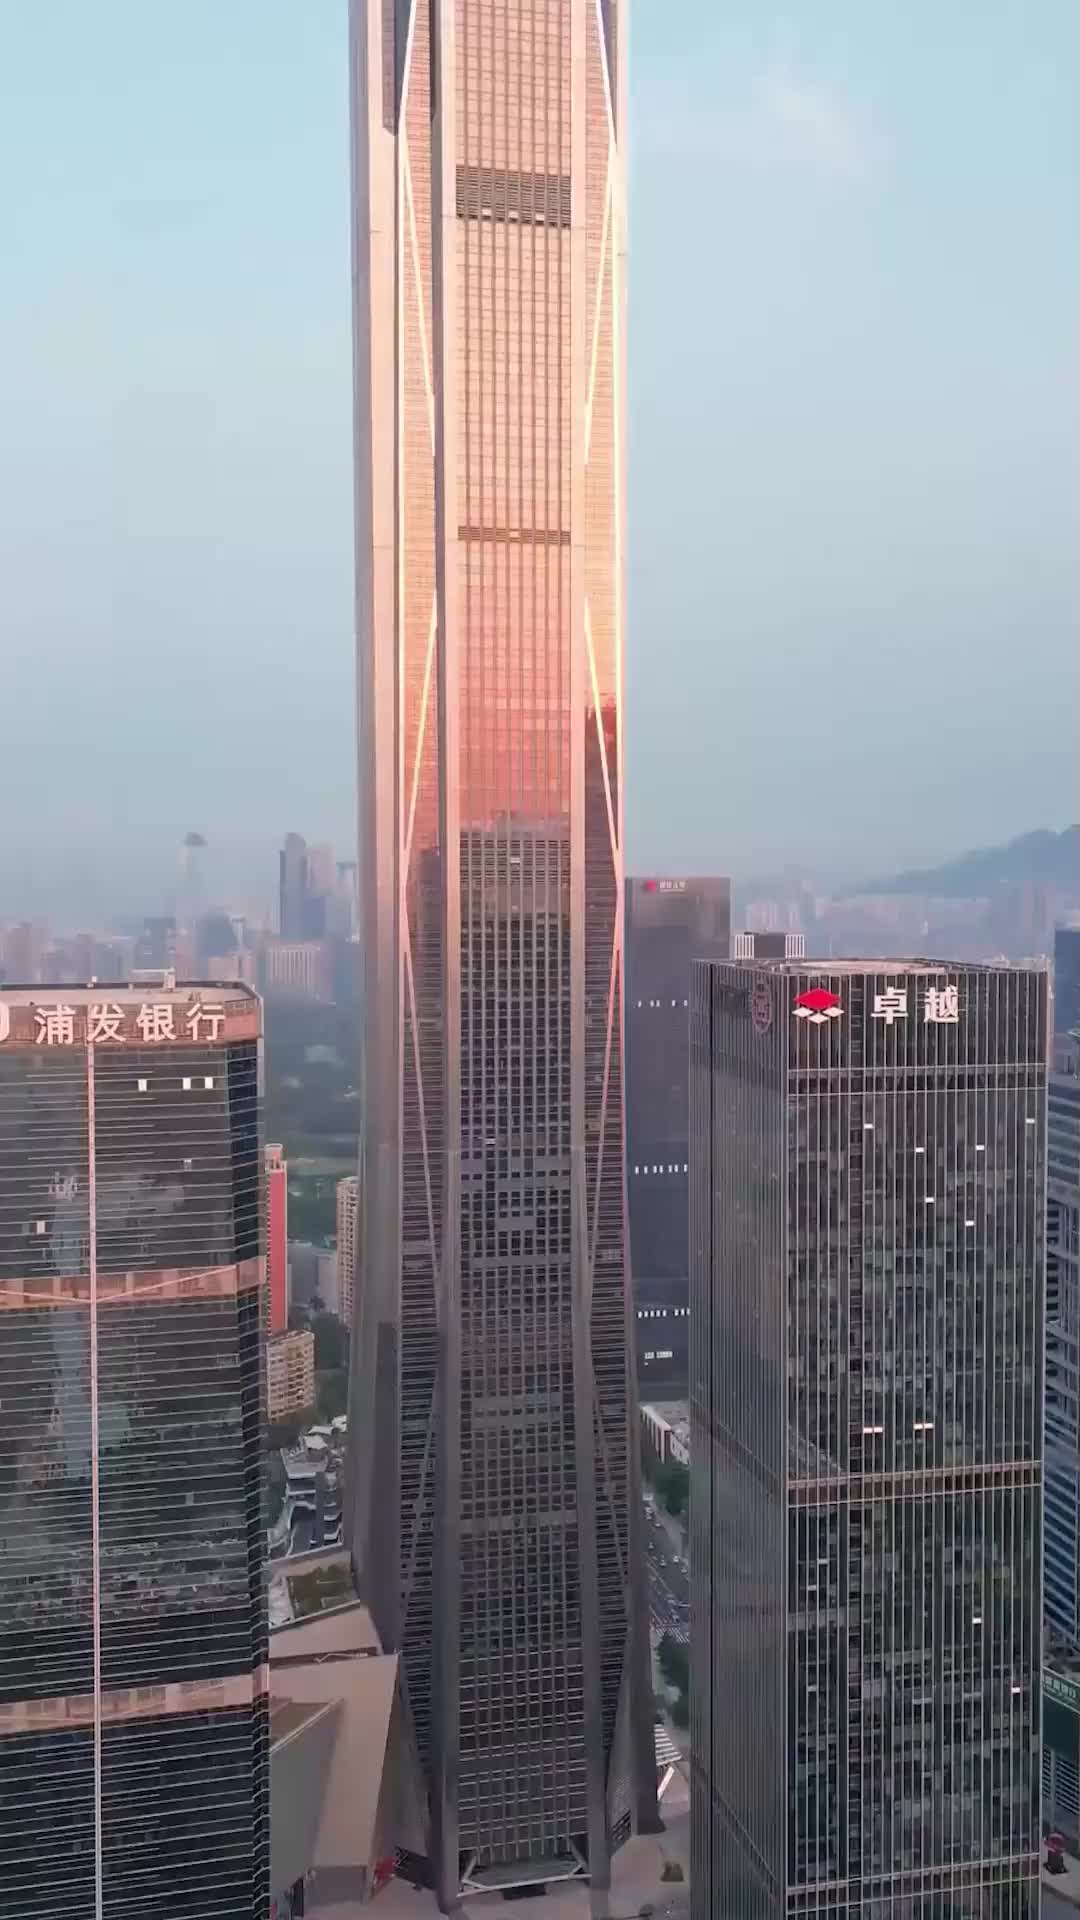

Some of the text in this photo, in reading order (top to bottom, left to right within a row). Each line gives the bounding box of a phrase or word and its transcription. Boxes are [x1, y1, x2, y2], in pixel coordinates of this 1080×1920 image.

[33, 1003, 226, 1044] 浦发银行
[871, 984, 960, 1024] 卓越
